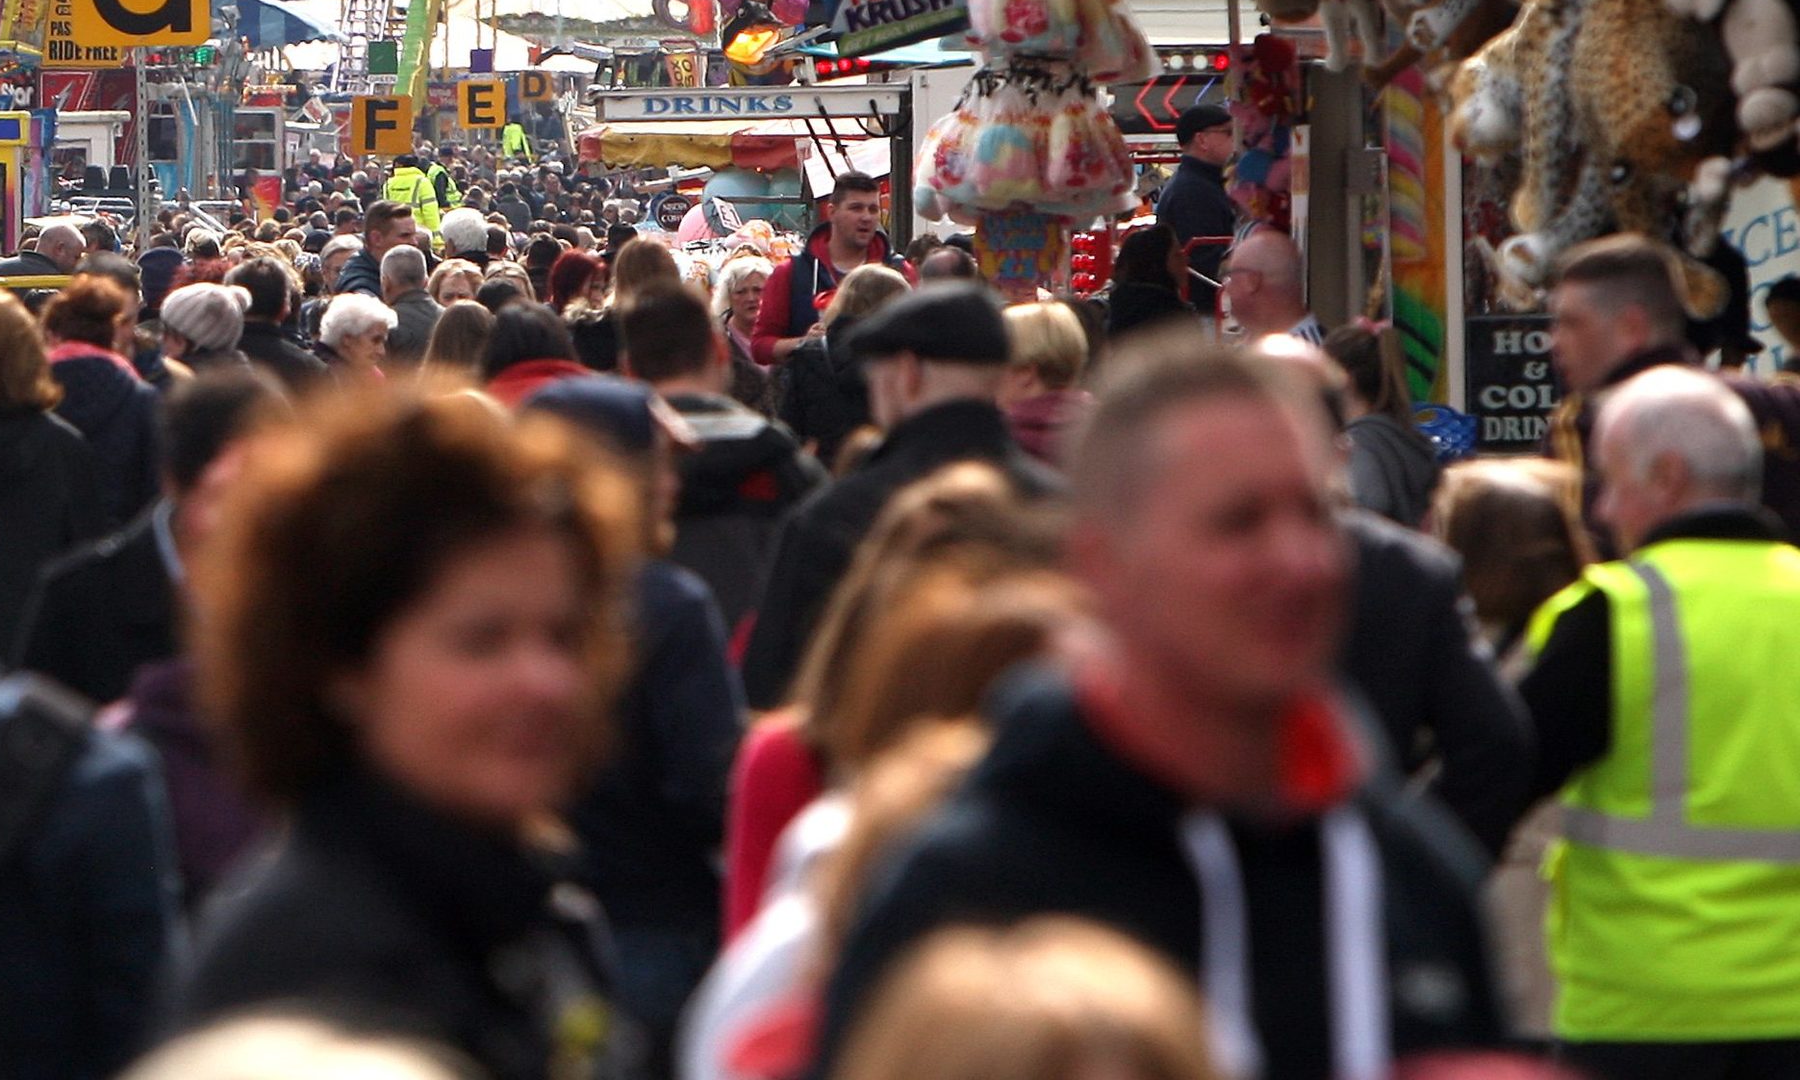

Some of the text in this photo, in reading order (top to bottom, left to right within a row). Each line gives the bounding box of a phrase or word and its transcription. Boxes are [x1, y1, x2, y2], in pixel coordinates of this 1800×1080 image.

[50, 21, 72, 36] PAS
[48, 40, 118, 61] RIDE FREE
[523, 71, 546, 98] D
[467, 84, 496, 125] E
[643, 95, 794, 115] DRINKS
[365, 100, 399, 151] F
[1493, 330, 1552, 355] HO
[1524, 360, 1548, 380] &
[1481, 385, 1560, 410] COL
[1484, 415, 1553, 440] DRIN
